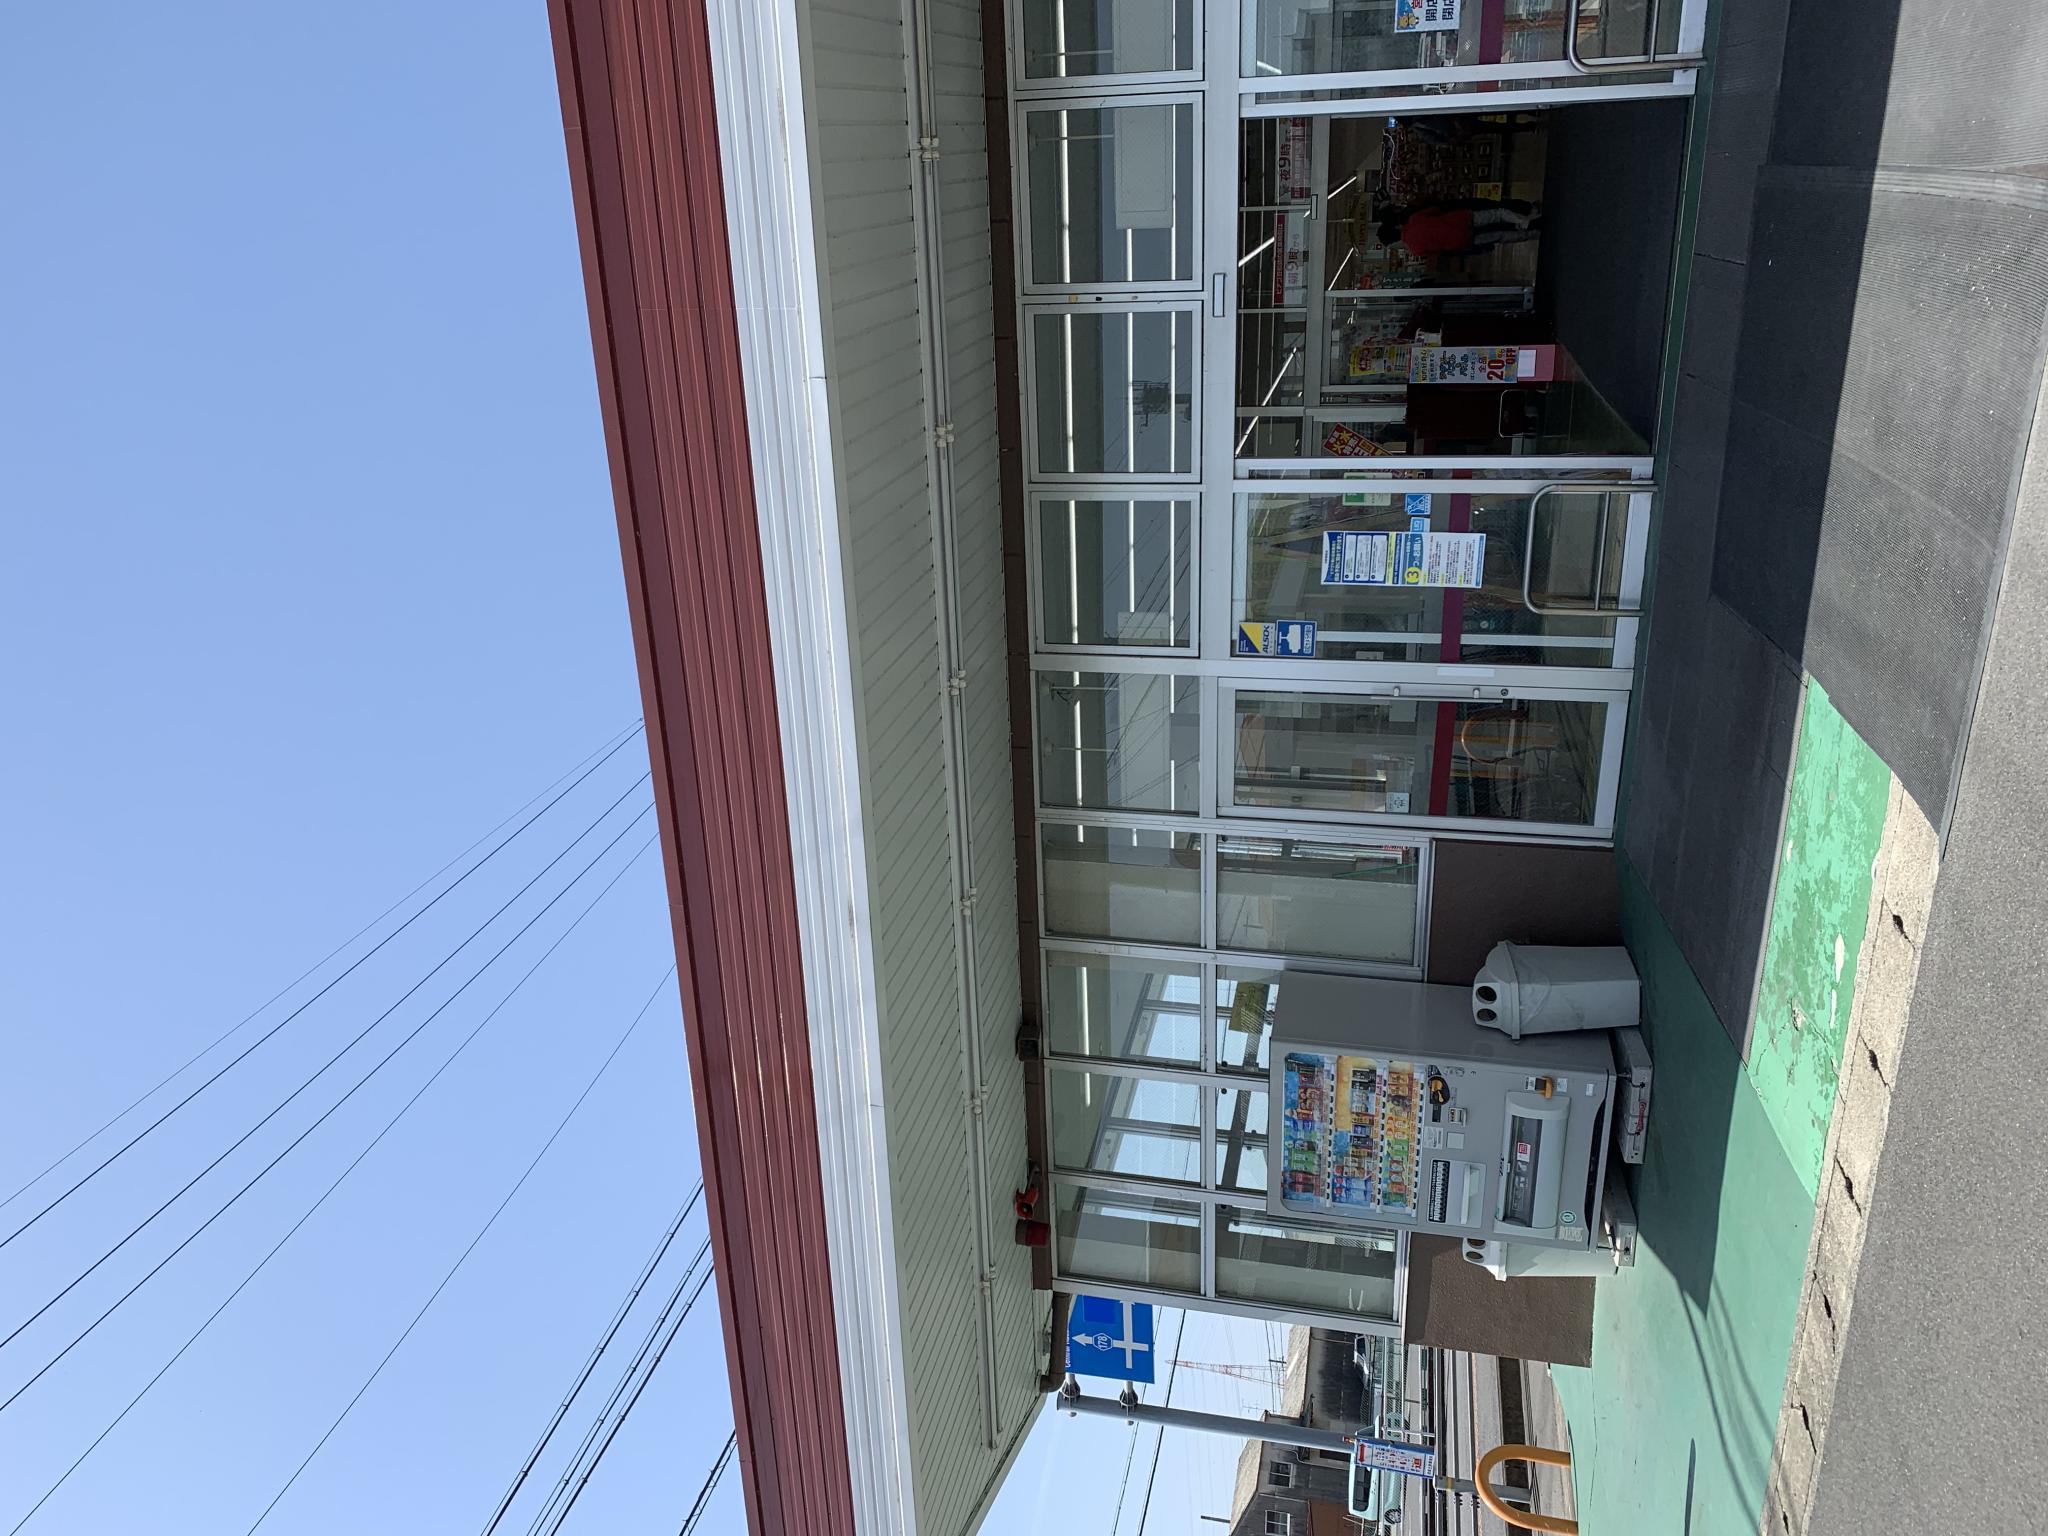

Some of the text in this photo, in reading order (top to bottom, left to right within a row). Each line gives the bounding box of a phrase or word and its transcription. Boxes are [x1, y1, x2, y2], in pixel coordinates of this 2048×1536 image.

[1425, 0, 1438, 22] 開店
[1478, 356, 1487, 373] 全品
[1505, 348, 1516, 364] OFF
[1262, 626, 1270, 654] ALSOK
[1098, 1336, 1108, 1348] 178
